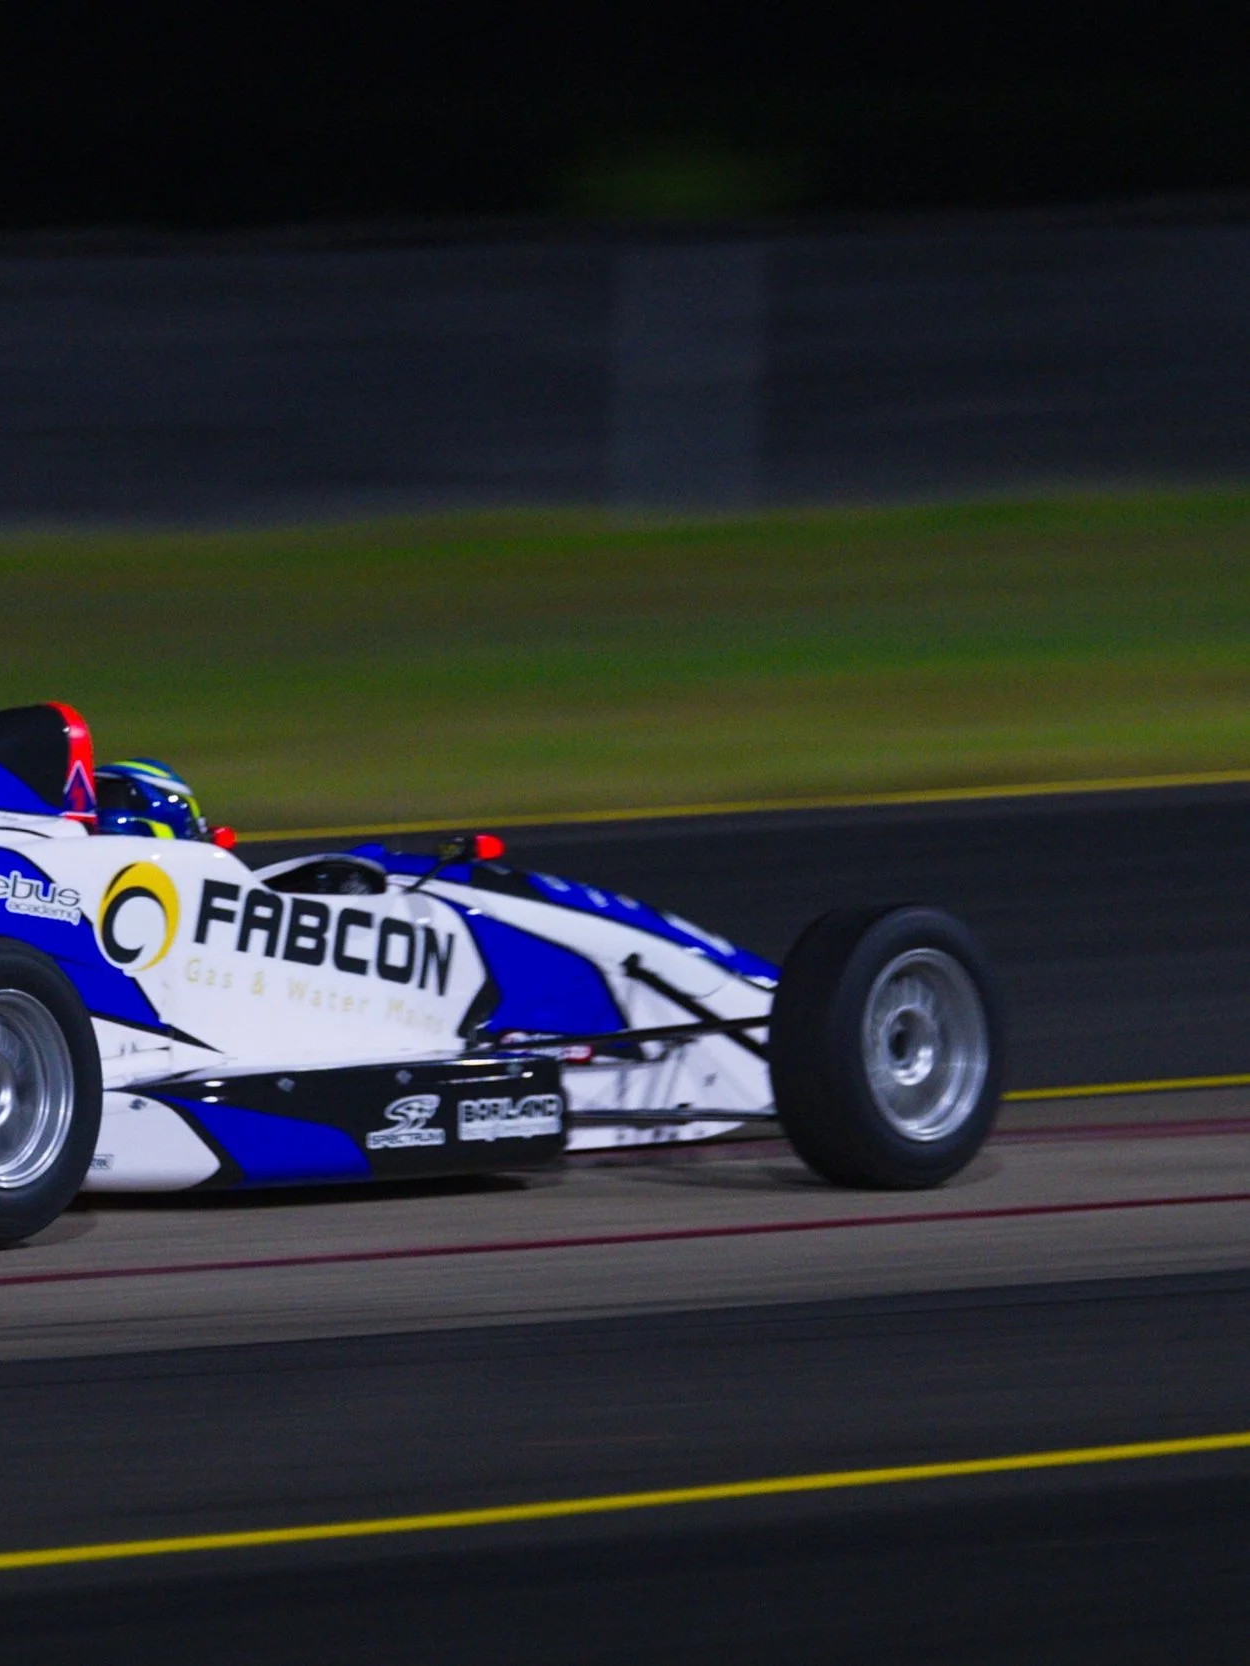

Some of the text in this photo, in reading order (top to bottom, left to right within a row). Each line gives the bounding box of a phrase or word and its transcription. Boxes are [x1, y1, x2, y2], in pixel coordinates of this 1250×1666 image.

[8, 901, 78, 923] academy
[194, 878, 456, 997] FABCON
[184, 957, 233, 989] Gas
[287, 976, 370, 1013] Water
